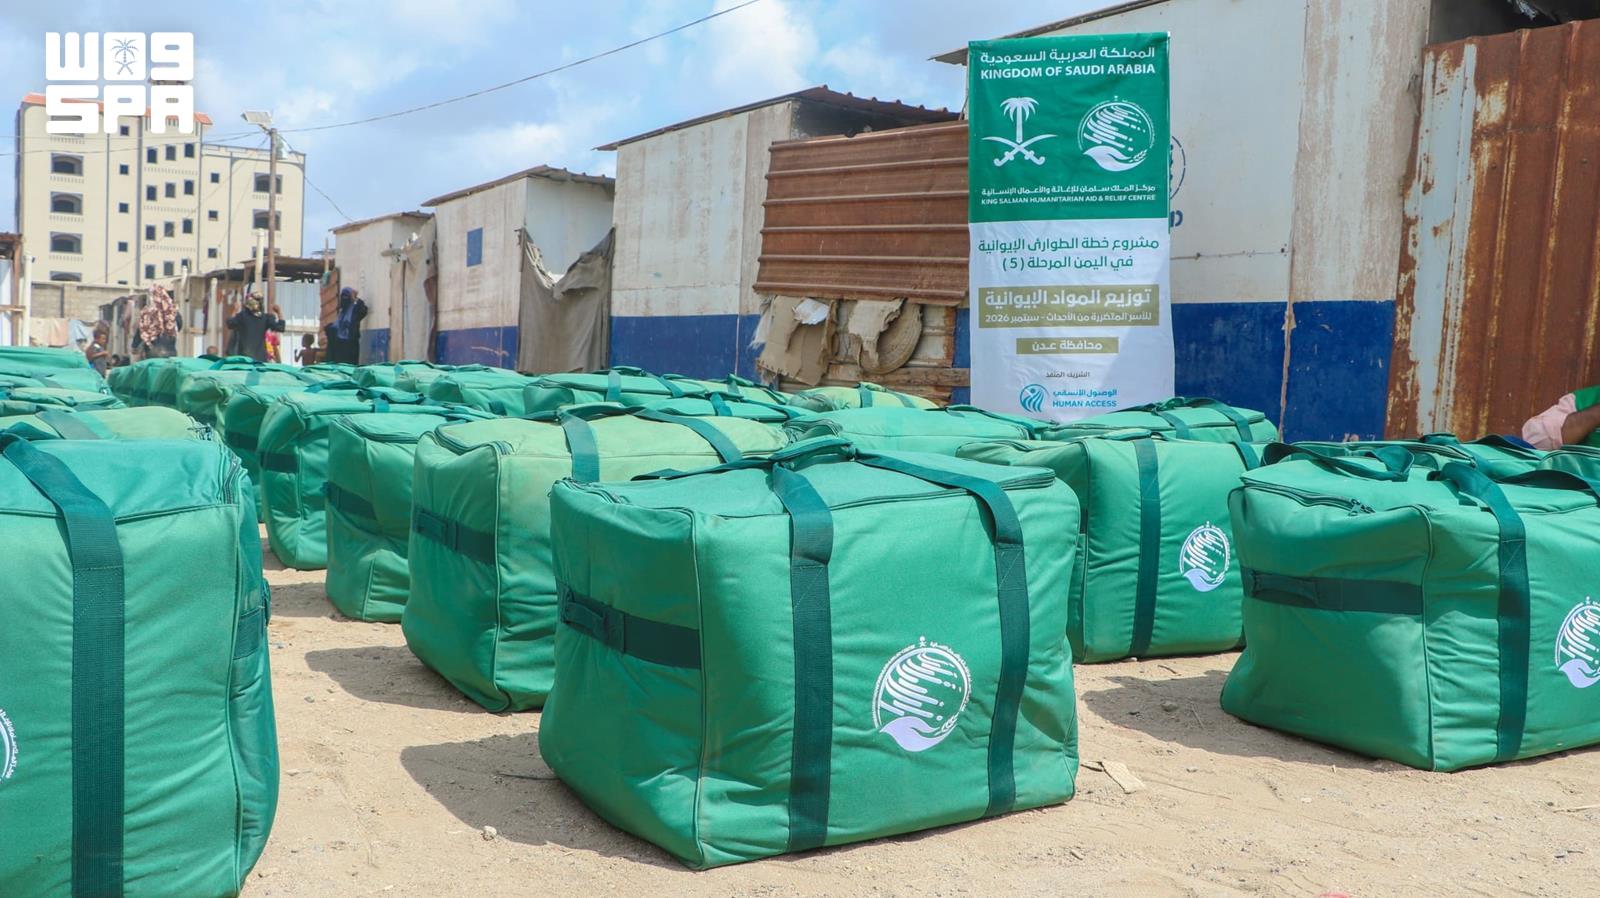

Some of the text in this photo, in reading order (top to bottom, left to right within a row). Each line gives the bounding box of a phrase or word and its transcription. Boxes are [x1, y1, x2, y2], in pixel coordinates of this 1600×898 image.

[980, 46, 1155, 66] المملكة العربية السعودية
[980, 63, 1156, 79] KINGDOM OF SAUDI ARABIA
[981, 187, 1017, 197] الإنسانية
[1079, 185, 1110, 193] سلمان
[1110, 184, 1135, 193] الملك
[1135, 184, 1156, 193] مركز
[1081, 236, 1109, 249] خطة
[1111, 236, 1160, 251] مشروع
[1027, 256, 1071, 270] المرحلة
[1074, 256, 1108, 271] اليمن
[1110, 255, 1134, 271] في
[1051, 289, 1100, 308] المواد
[1104, 288, 1152, 307] توزيع
[985, 314, 1009, 323] 2026
[1010, 314, 1040, 323] سبتمبر
[1077, 313, 1090, 322] من
[1091, 311, 1129, 323] المتضررة
[1032, 339, 1103, 352] محافظة عدن
[1086, 389, 1117, 398] الوصول
